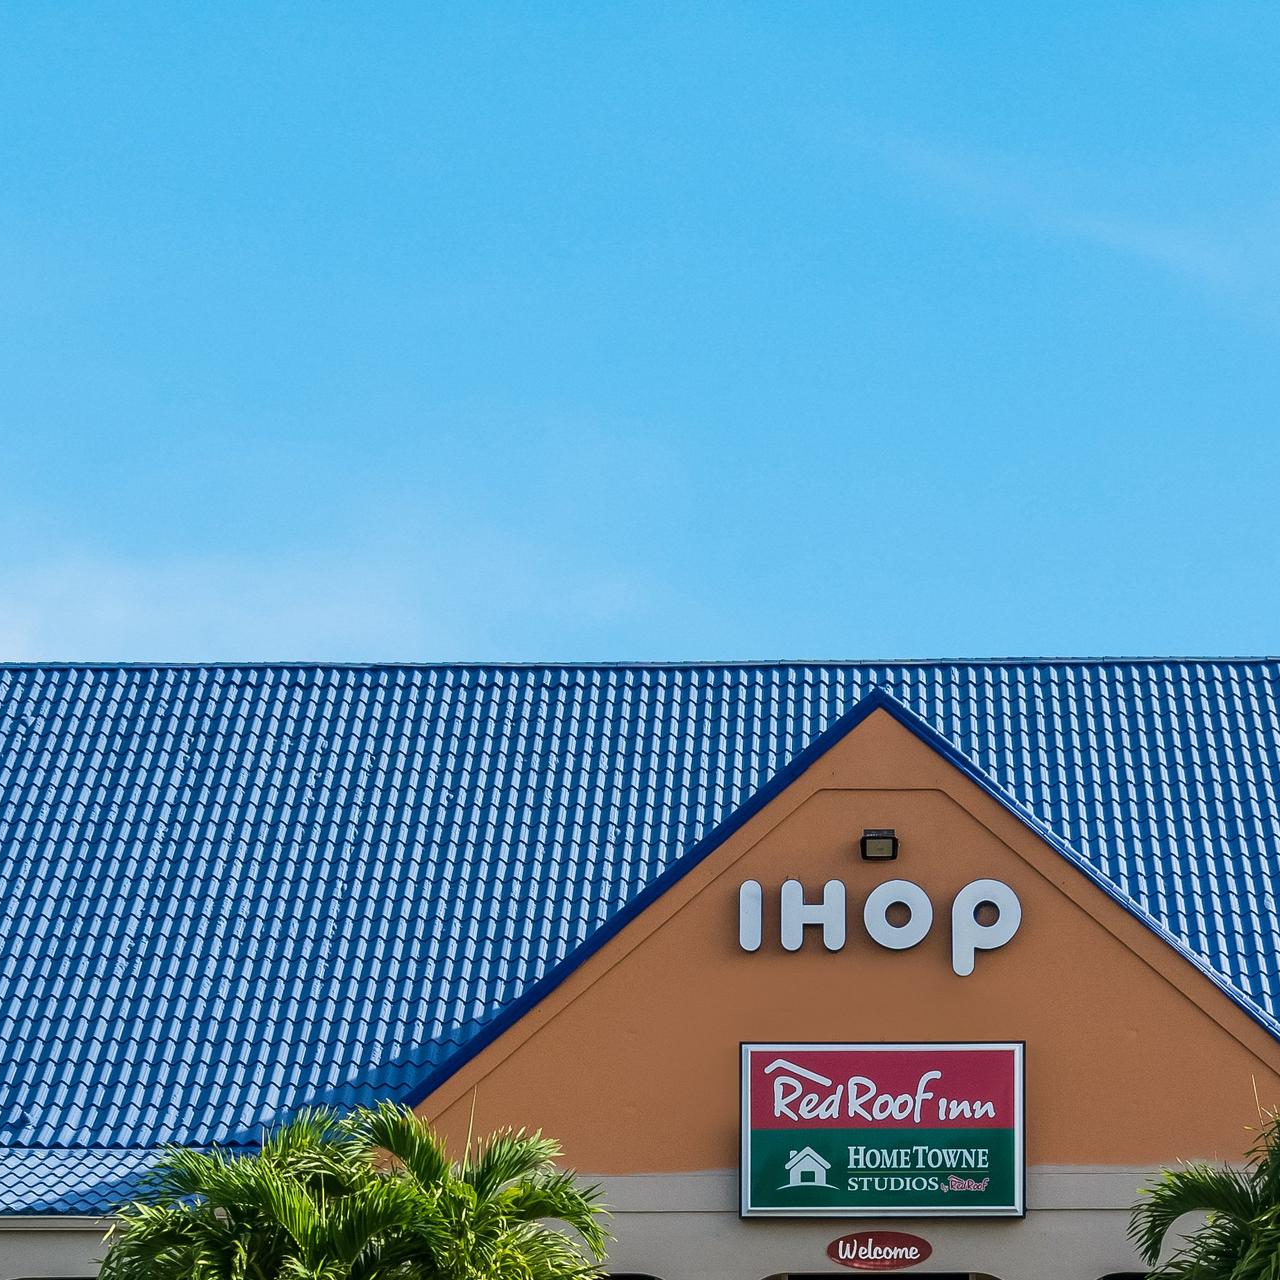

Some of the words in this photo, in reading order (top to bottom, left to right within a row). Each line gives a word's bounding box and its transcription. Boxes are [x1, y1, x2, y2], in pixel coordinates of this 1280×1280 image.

[739, 878, 1022, 977] IHOP
[773, 1075, 844, 1122] Red
[847, 1070, 942, 1123] Roof
[847, 1176, 939, 1191] STUDIOS
[838, 1238, 921, 1259] Welcome
